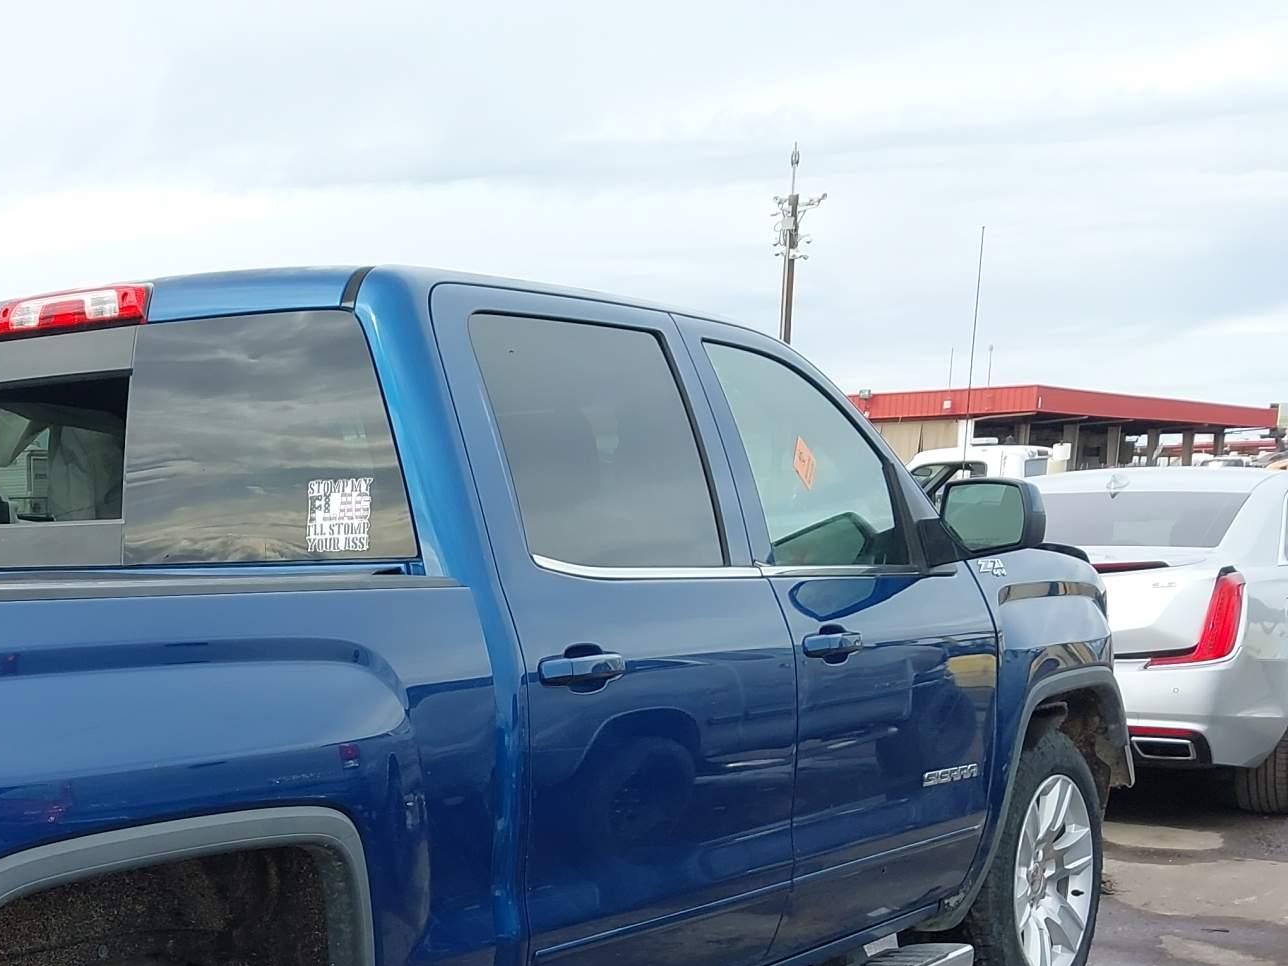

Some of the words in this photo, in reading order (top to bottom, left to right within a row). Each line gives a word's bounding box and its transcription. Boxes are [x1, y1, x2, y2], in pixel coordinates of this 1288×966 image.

[308, 479, 349, 495] STOMP
[350, 477, 373, 493] MY
[309, 492, 371, 521] FLAG
[328, 521, 370, 536] STOMP
[306, 536, 342, 552] YOUR
[922, 763, 977, 788] SIERRA
